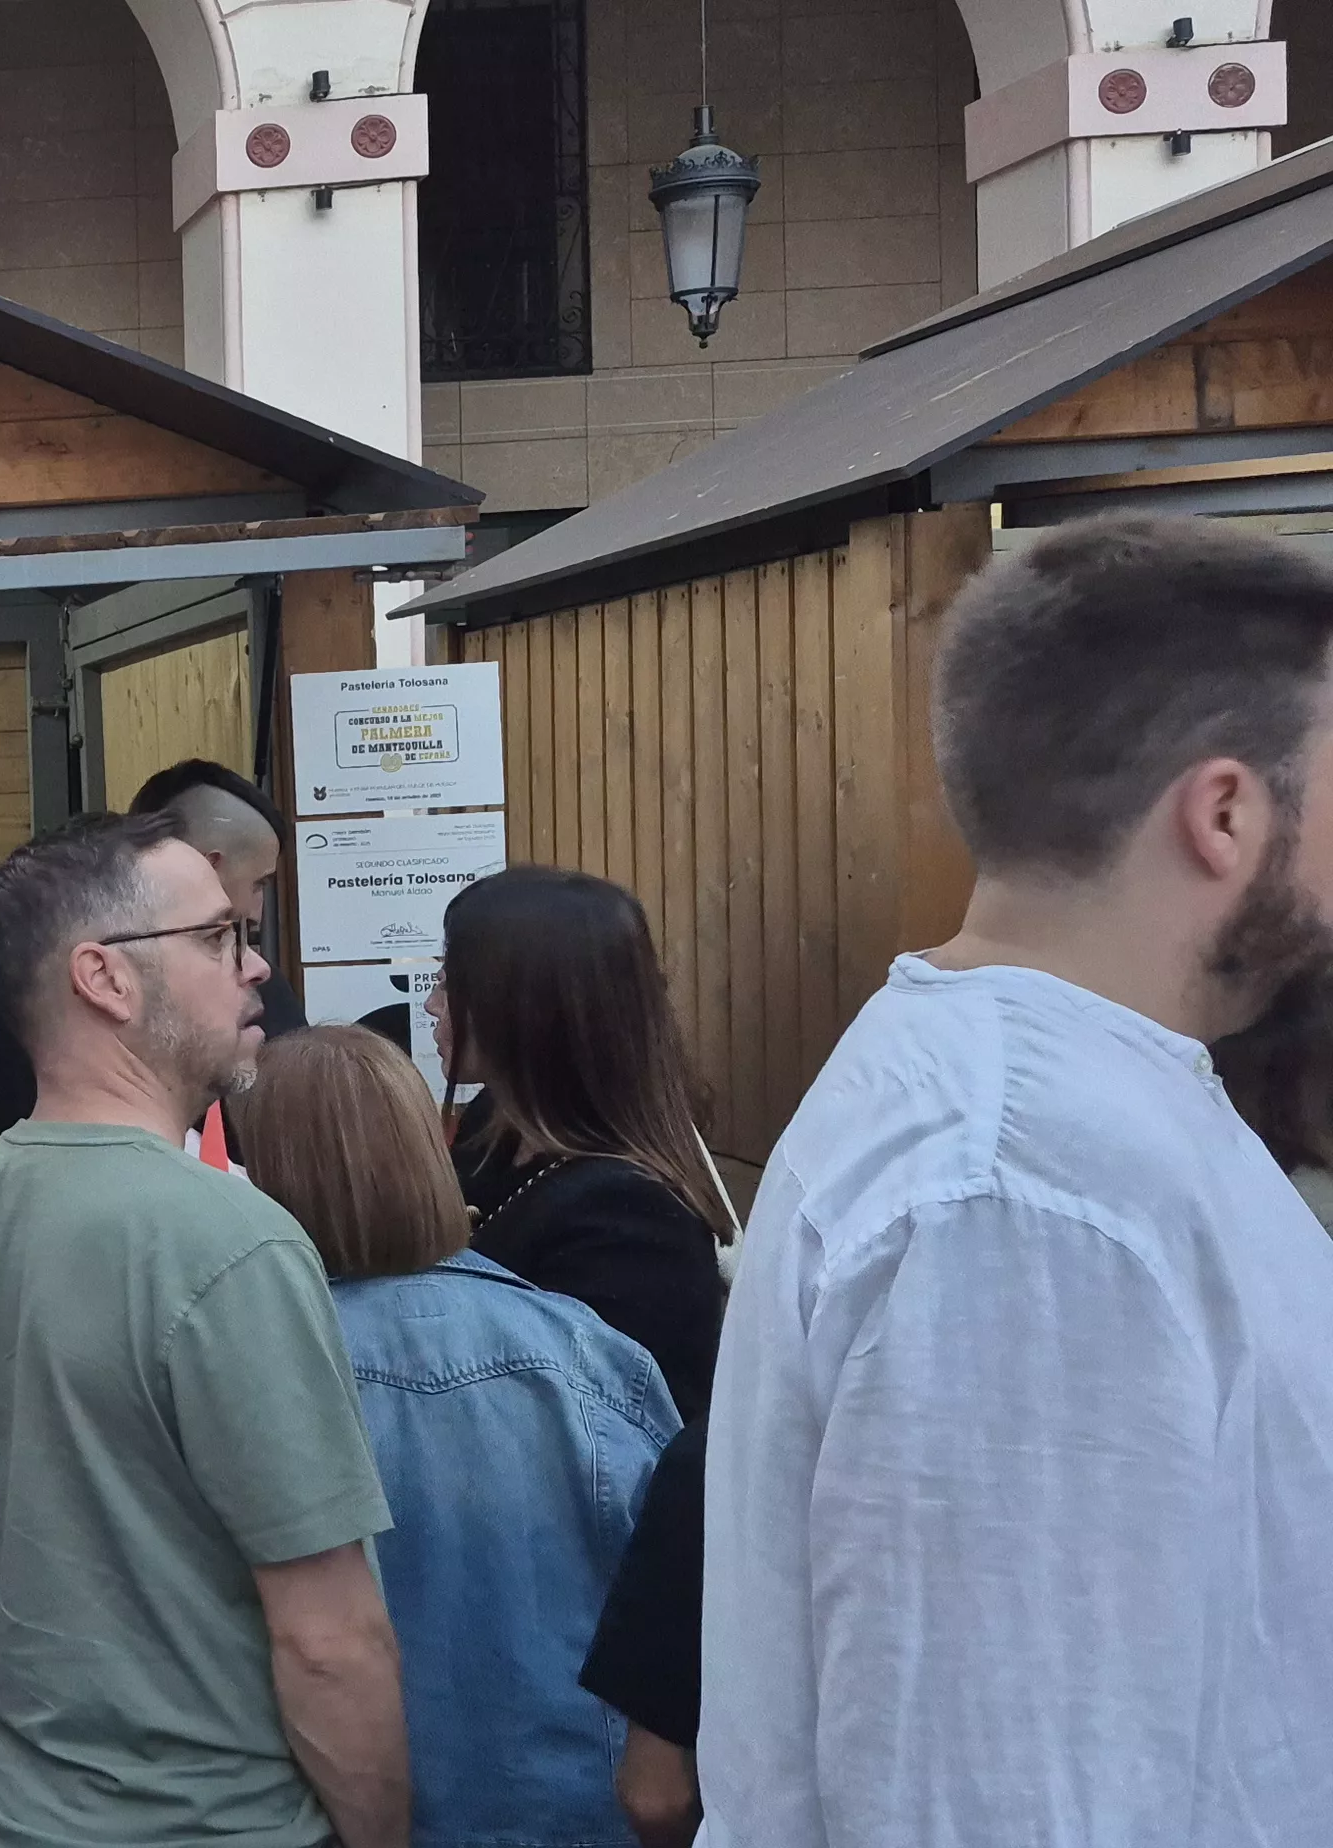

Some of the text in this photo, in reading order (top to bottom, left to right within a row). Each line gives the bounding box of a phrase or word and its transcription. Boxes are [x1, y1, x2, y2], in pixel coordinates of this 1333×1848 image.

[398, 676, 449, 688] Tolosana
[348, 715, 390, 726] CONCURSO
[393, 715, 399, 723] A
[400, 714, 412, 723] LA
[361, 725, 432, 741] PALMERA
[351, 740, 443, 754] DE MANTEQUILLA
[405, 753, 417, 761] DE
[355, 857, 450, 869] SEGUNDO CLASIFICADO
[328, 872, 476, 888] Pastelería Tolosana
[414, 973, 438, 982] PRE
